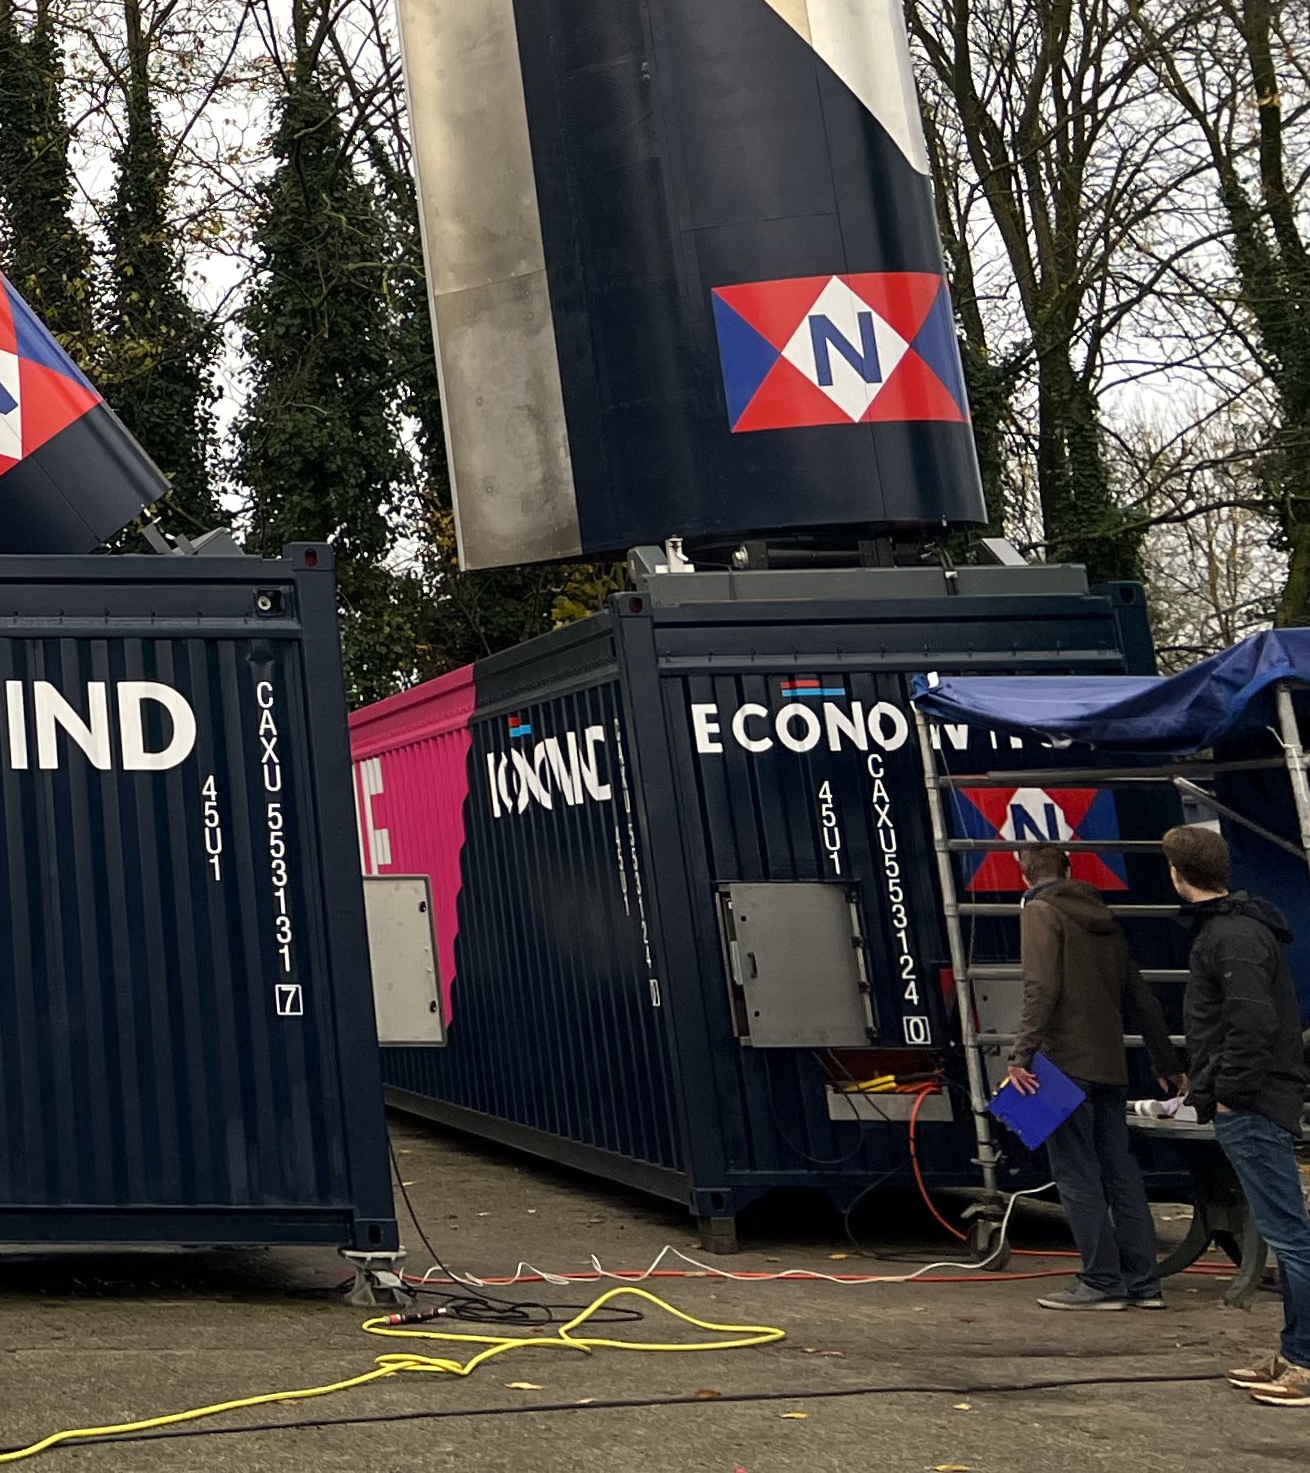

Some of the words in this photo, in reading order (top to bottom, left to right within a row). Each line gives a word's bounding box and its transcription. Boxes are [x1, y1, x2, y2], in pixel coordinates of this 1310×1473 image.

[808, 311, 883, 386] N
[256, 681, 282, 792] CAXU
[202, 775, 223, 881] 45U1
[818, 781, 841, 875] 45U1
[1010, 803, 1061, 841] N
[267, 803, 291, 972] 553131
[278, 985, 299, 1015] 7
[906, 1017, 928, 1043] 0
